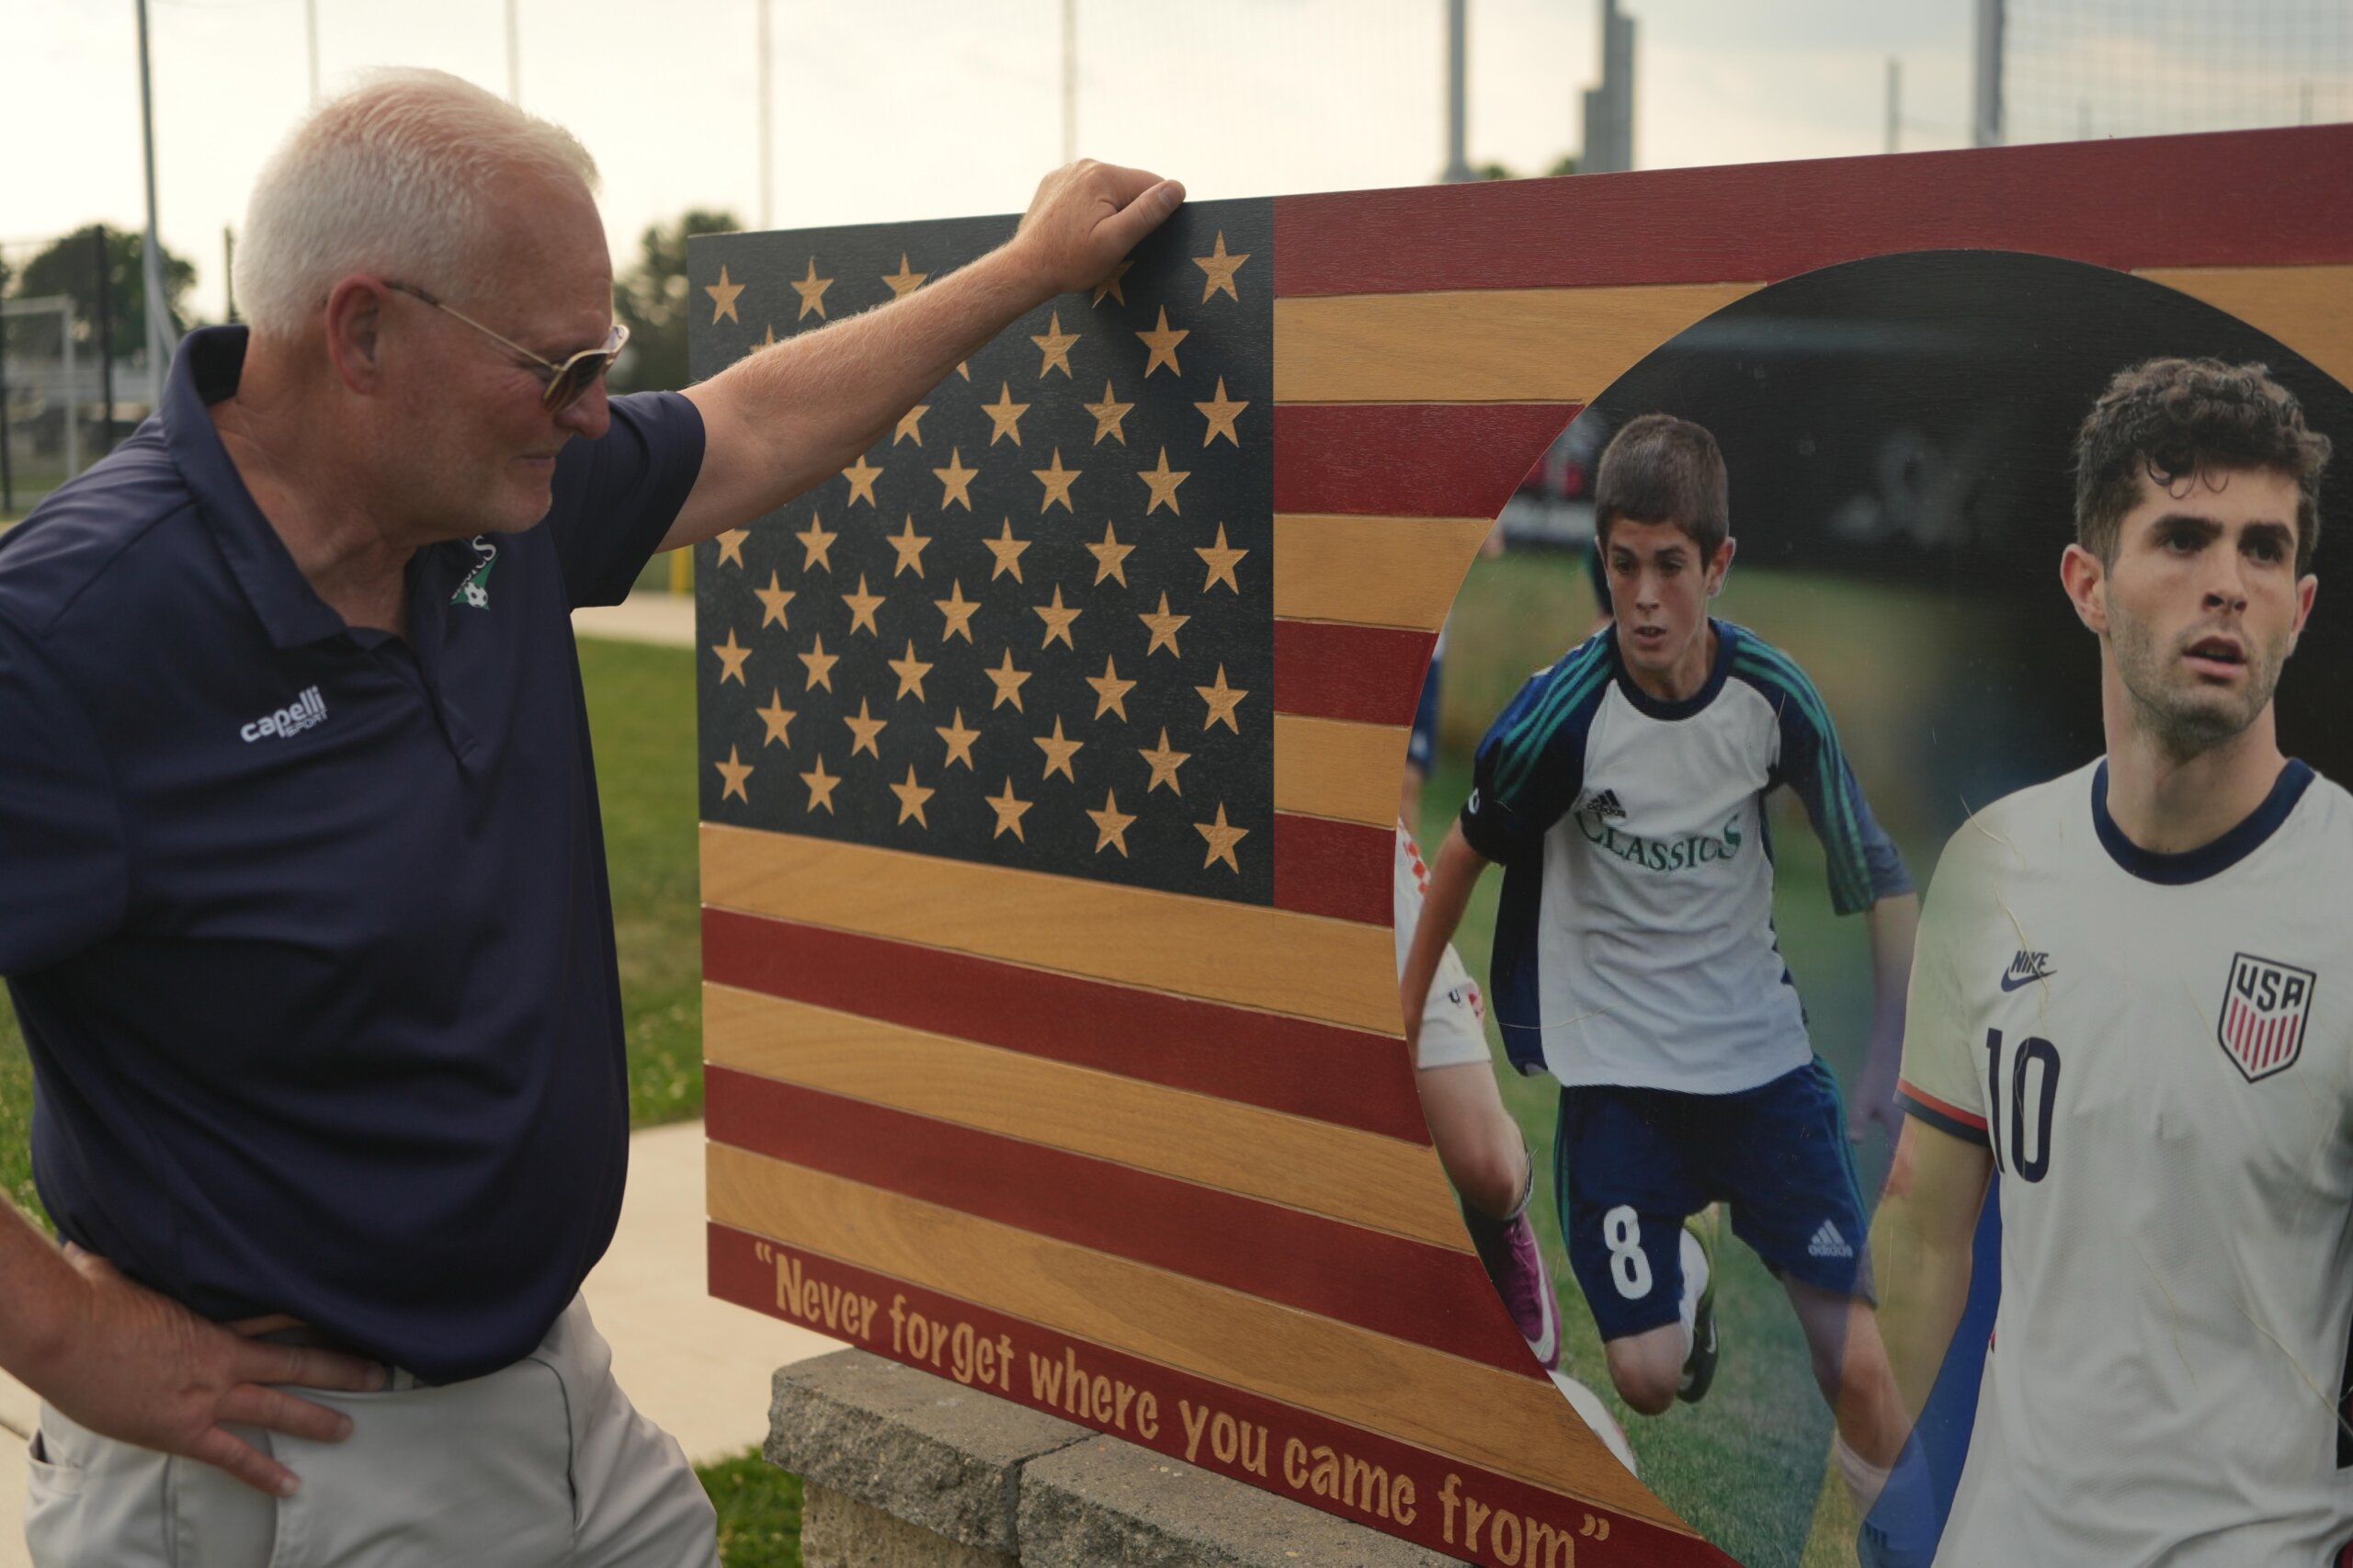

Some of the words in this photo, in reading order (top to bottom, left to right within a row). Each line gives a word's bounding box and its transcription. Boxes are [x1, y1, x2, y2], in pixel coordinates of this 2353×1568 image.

[240, 685, 325, 743] capelli
[1574, 811, 1742, 871] CLASSICS
[2010, 950, 2049, 974] NIKE
[2236, 962, 2304, 1012] USA
[1986, 1027, 2061, 1183] 10
[1604, 1204, 1653, 1300] 8
[755, 1241, 878, 1340] “Never
[889, 1294, 1015, 1392] forget
[1029, 1347, 1159, 1439] where
[1179, 1399, 1268, 1477] you
[1283, 1437, 1416, 1526] came
